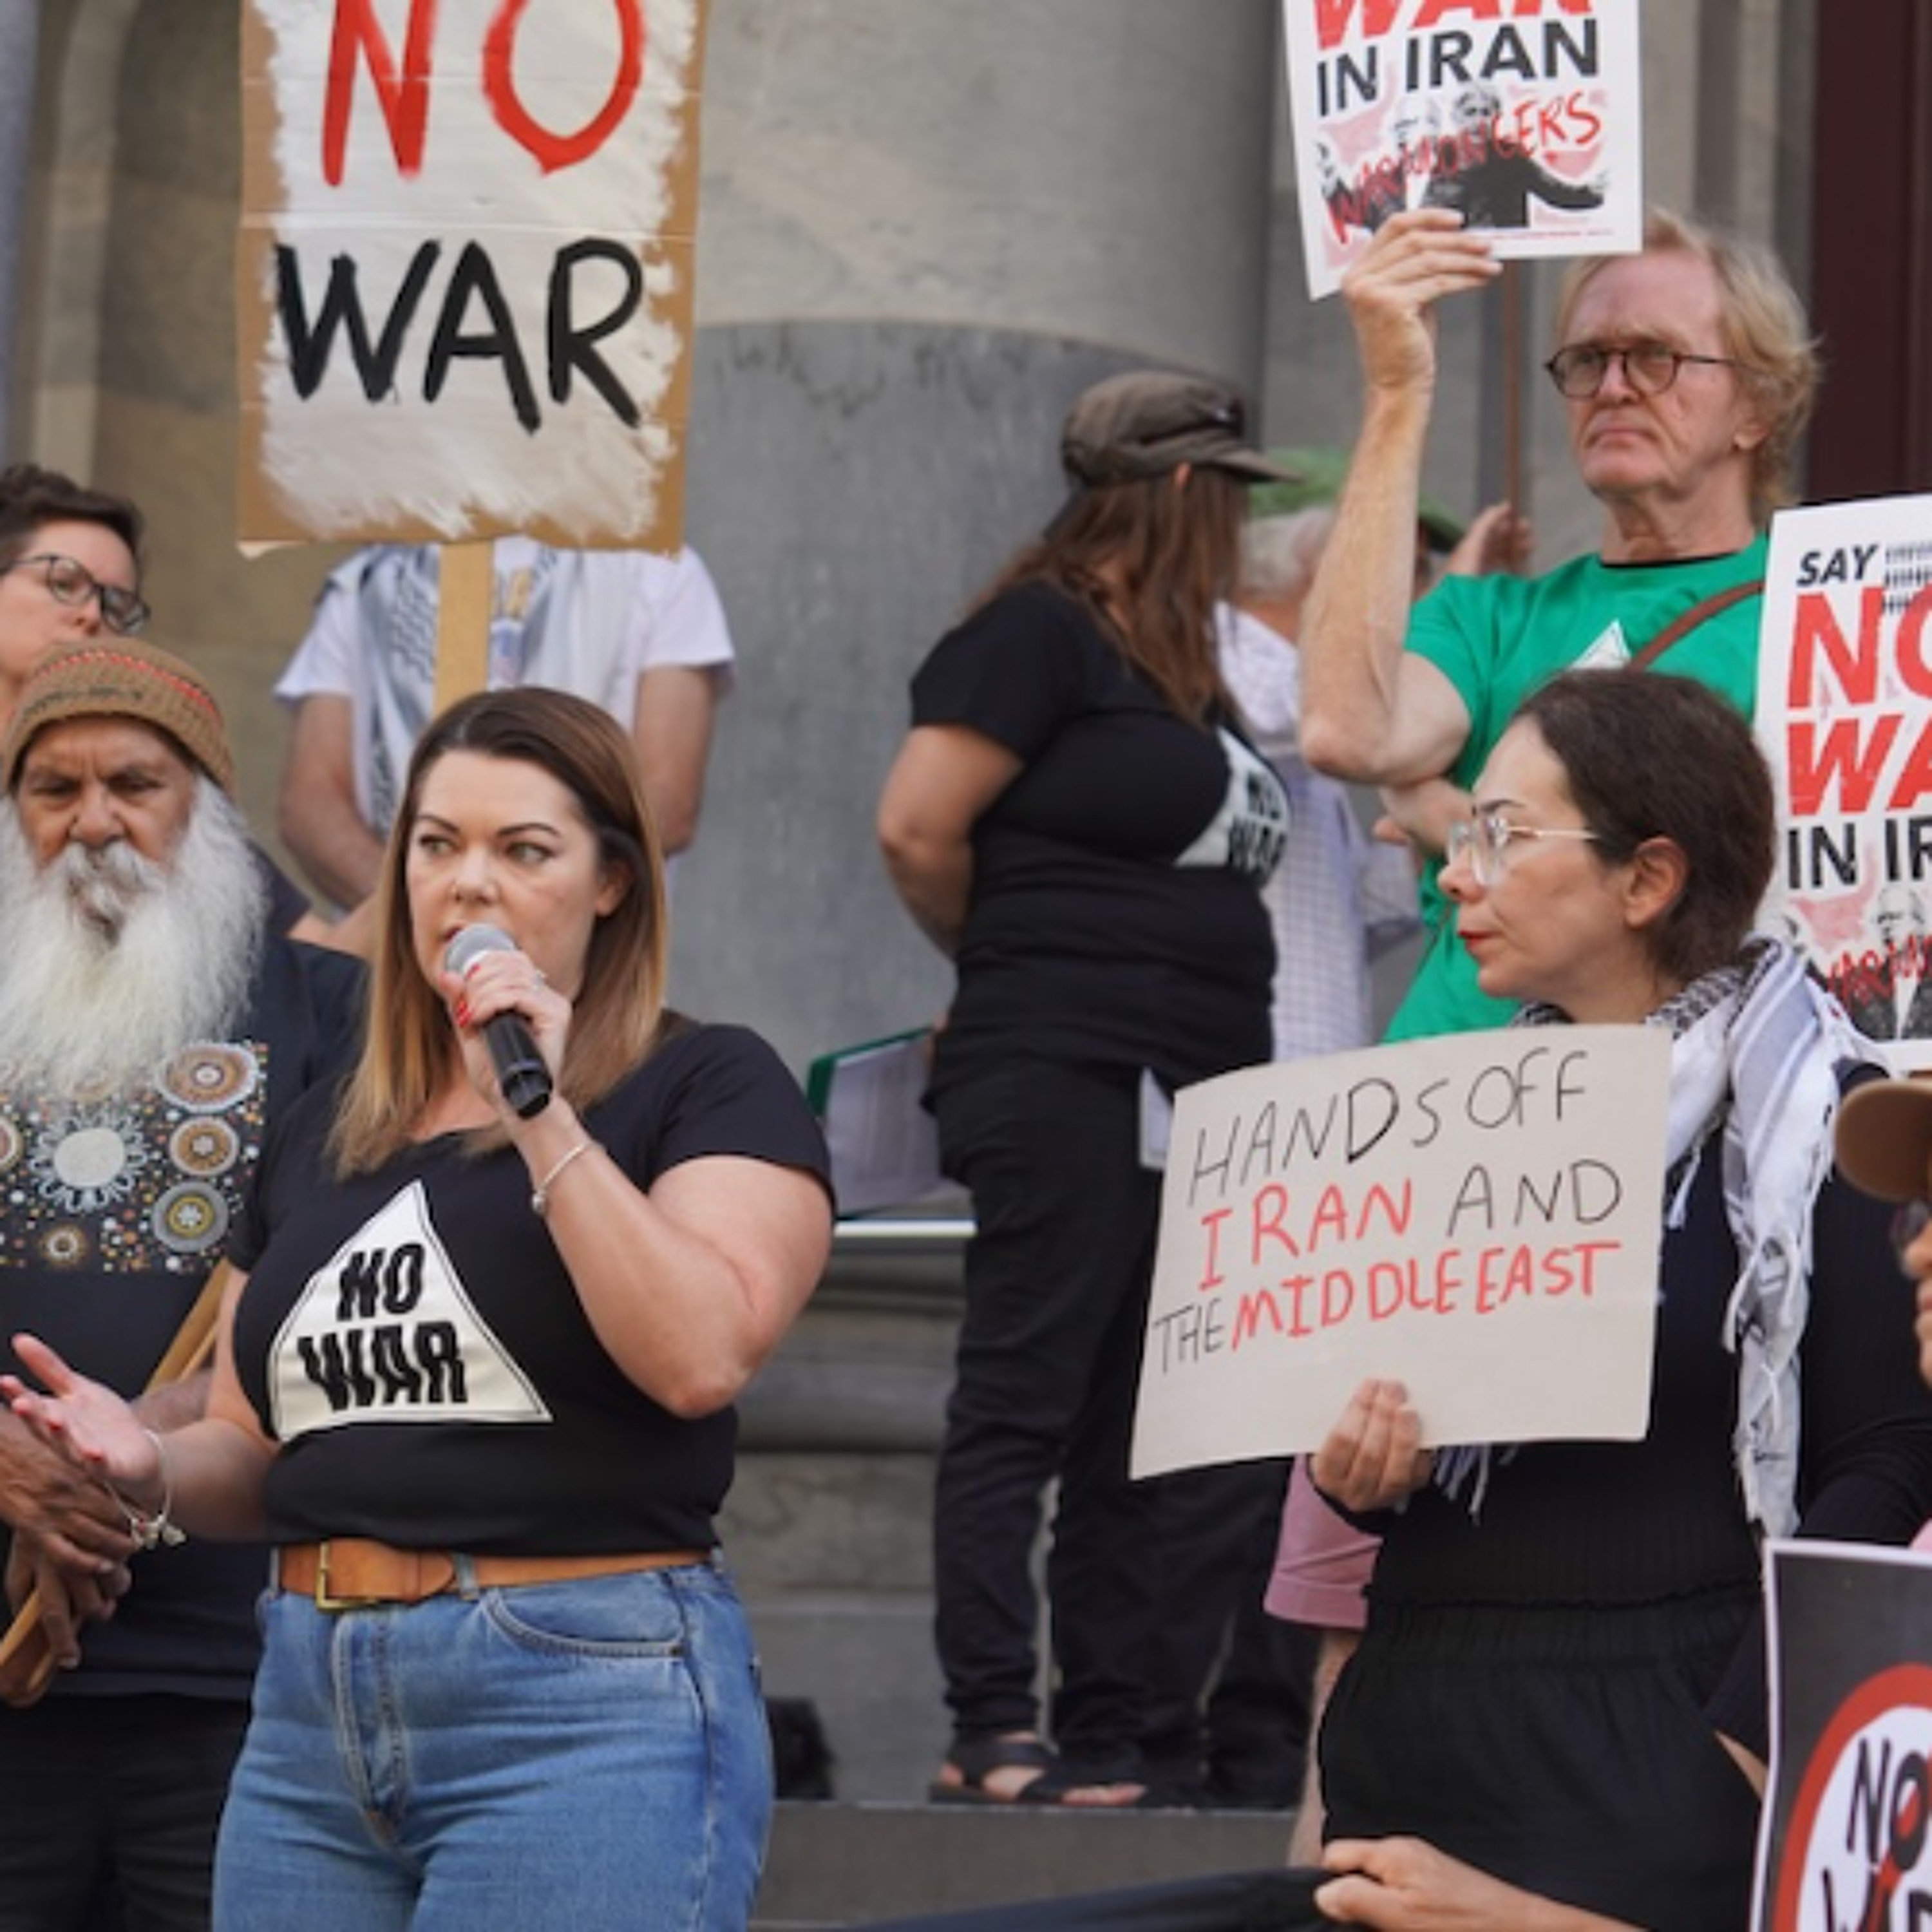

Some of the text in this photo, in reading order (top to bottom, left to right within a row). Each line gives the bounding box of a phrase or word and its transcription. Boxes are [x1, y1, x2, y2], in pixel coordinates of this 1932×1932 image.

[321, 0, 645, 186] NO
[1317, 46, 1378, 117] IN
[1405, 18, 1598, 91] IRAN
[273, 237, 643, 436] WAR
[1795, 543, 1879, 587] SAY
[1788, 822, 1856, 890] IN
[1186, 1048, 1588, 1207] HANDS OFF
[336, 1243, 425, 1321] NO
[1198, 1159, 1622, 1291] IRAN AND
[298, 1321, 468, 1412] WAR
[1153, 1240, 1622, 1374] THE MIDDLE EAST
[1846, 1737, 1929, 1872] NO
